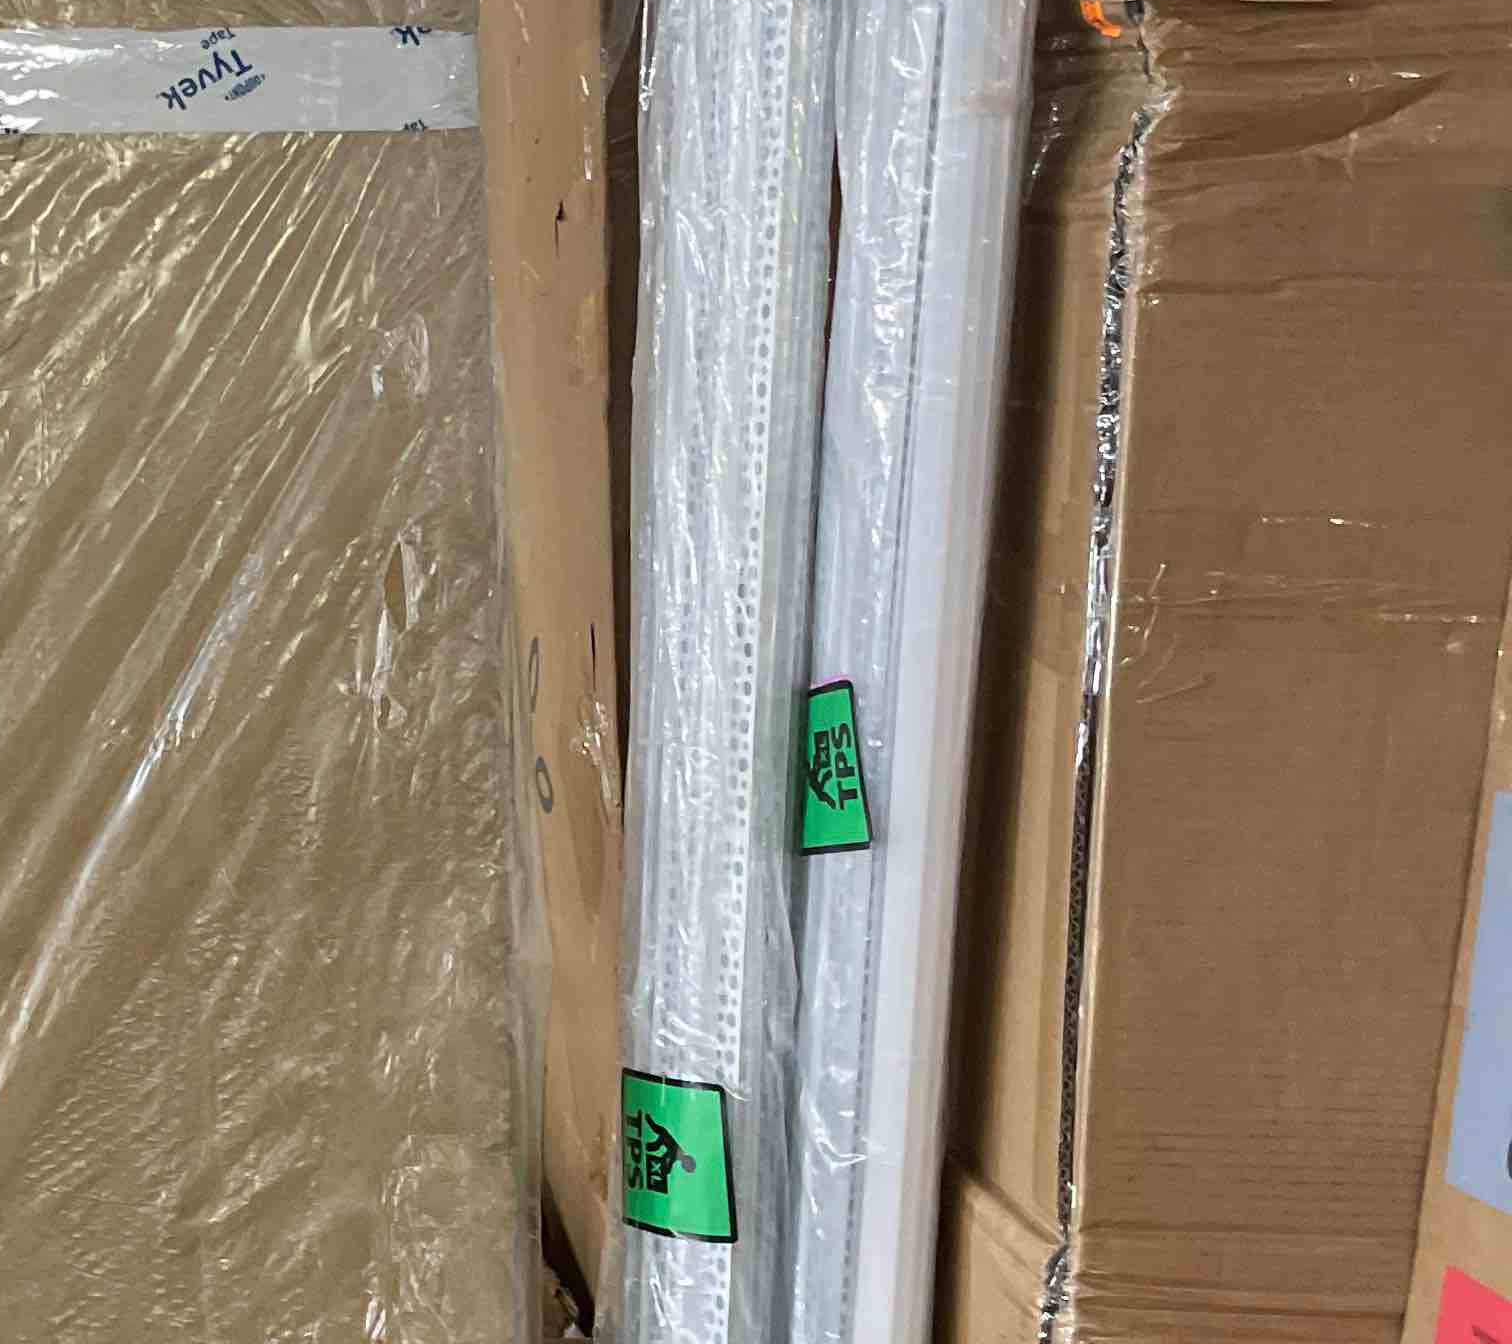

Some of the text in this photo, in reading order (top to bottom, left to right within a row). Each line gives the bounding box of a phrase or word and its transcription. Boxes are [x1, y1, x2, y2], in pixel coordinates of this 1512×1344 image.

[200, 26, 237, 50] Tape
[156, 49, 253, 111] Tyvek
[833, 723, 859, 810] TPS
[626, 1109, 645, 1190] TPS
